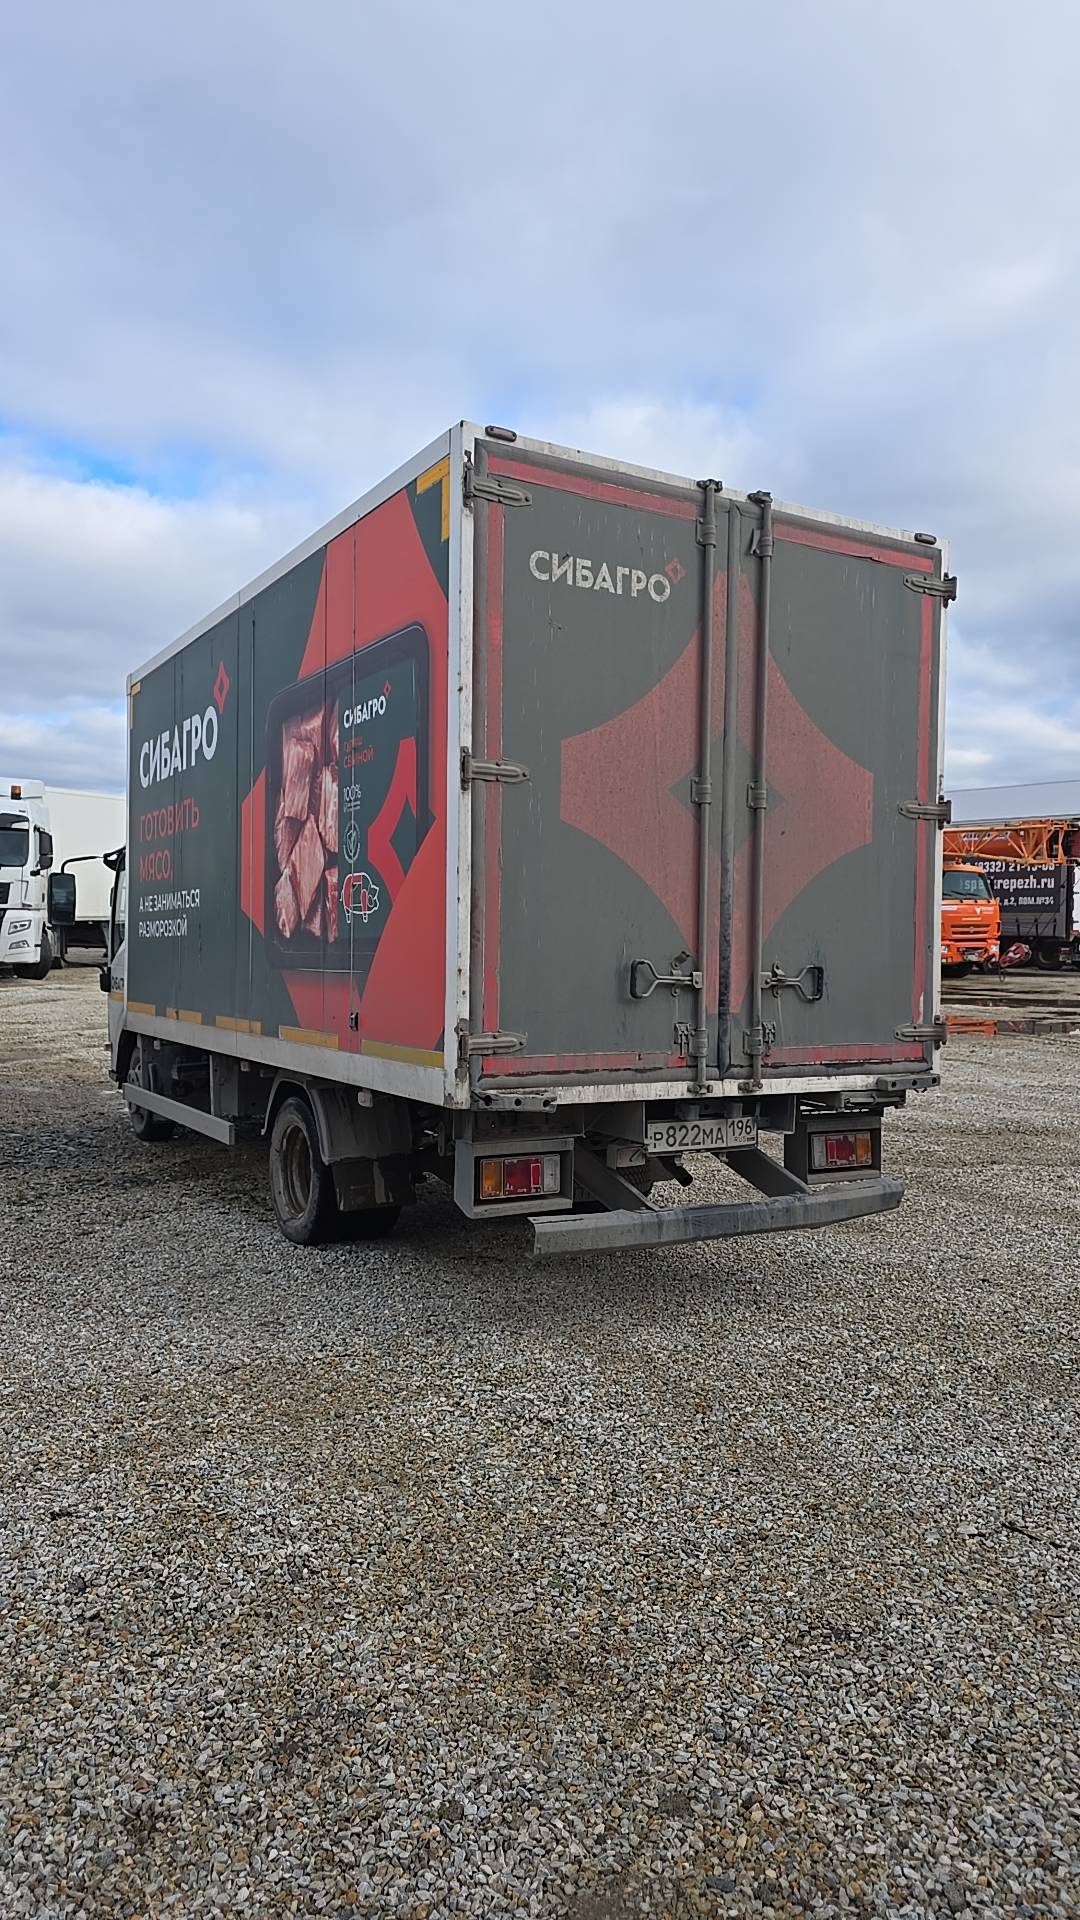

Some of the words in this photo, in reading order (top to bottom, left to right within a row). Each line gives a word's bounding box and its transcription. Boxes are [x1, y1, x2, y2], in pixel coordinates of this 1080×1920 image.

[529, 550, 671, 603] СИБАГРО
[344, 695, 386, 729] СИБАГРО
[139, 705, 218, 788] СИБАГРО
[344, 784, 361, 802] 100%
[139, 797, 200, 842] ГОТОВИТЬ
[153, 889, 200, 911] ЗАНИМАТЬСЯ
[138, 914, 188, 938] РАЗМОРОЗКОЙ
[653, 1123, 725, 1149] Р822МА
[728, 1118, 752, 1137] 196
